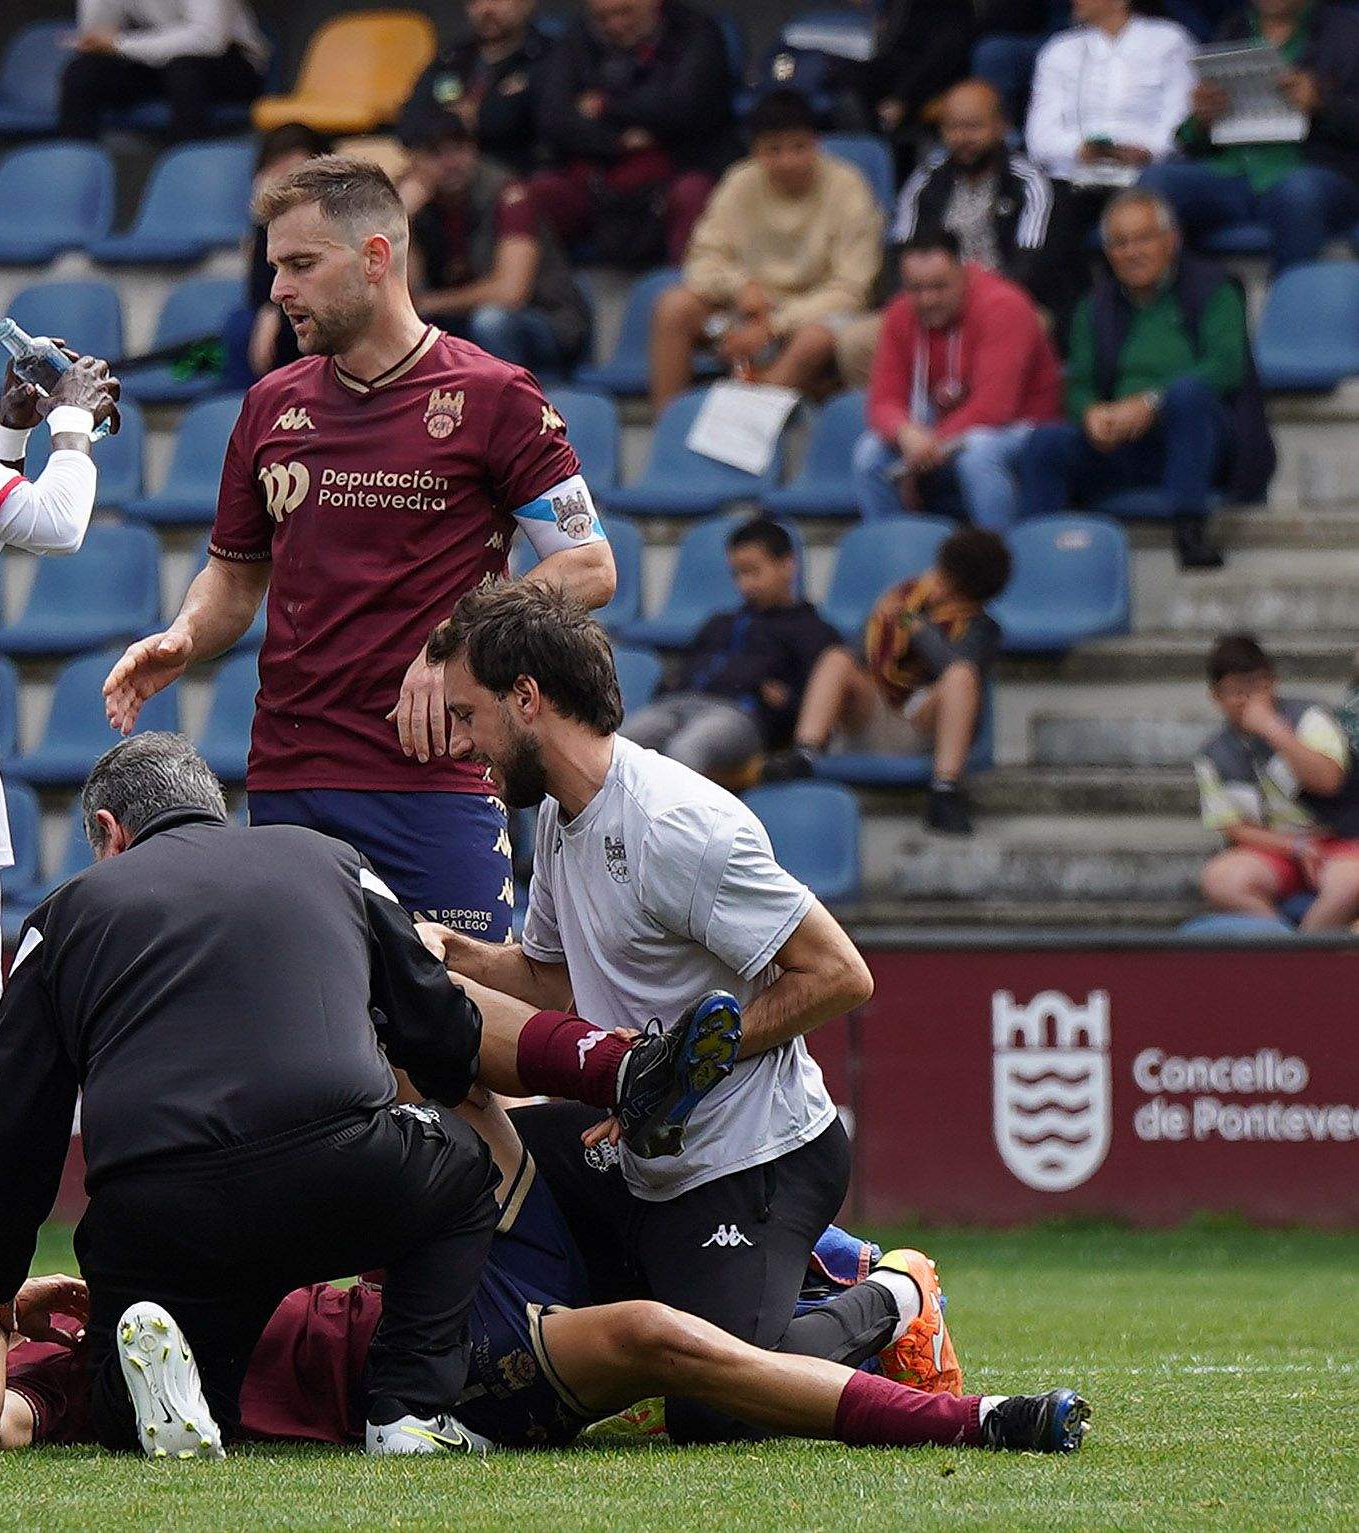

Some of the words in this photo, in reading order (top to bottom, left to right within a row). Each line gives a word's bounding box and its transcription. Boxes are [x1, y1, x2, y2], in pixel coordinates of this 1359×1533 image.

[322, 469, 448, 491] Deputación
[318, 490, 446, 511] Pontevedra
[442, 909, 492, 922] DEPORTE
[442, 920, 488, 931] GALEGO
[1132, 1047, 1309, 1094] Concello
[1133, 1097, 1191, 1142] de
[1194, 1096, 1359, 1142] Ponteve
